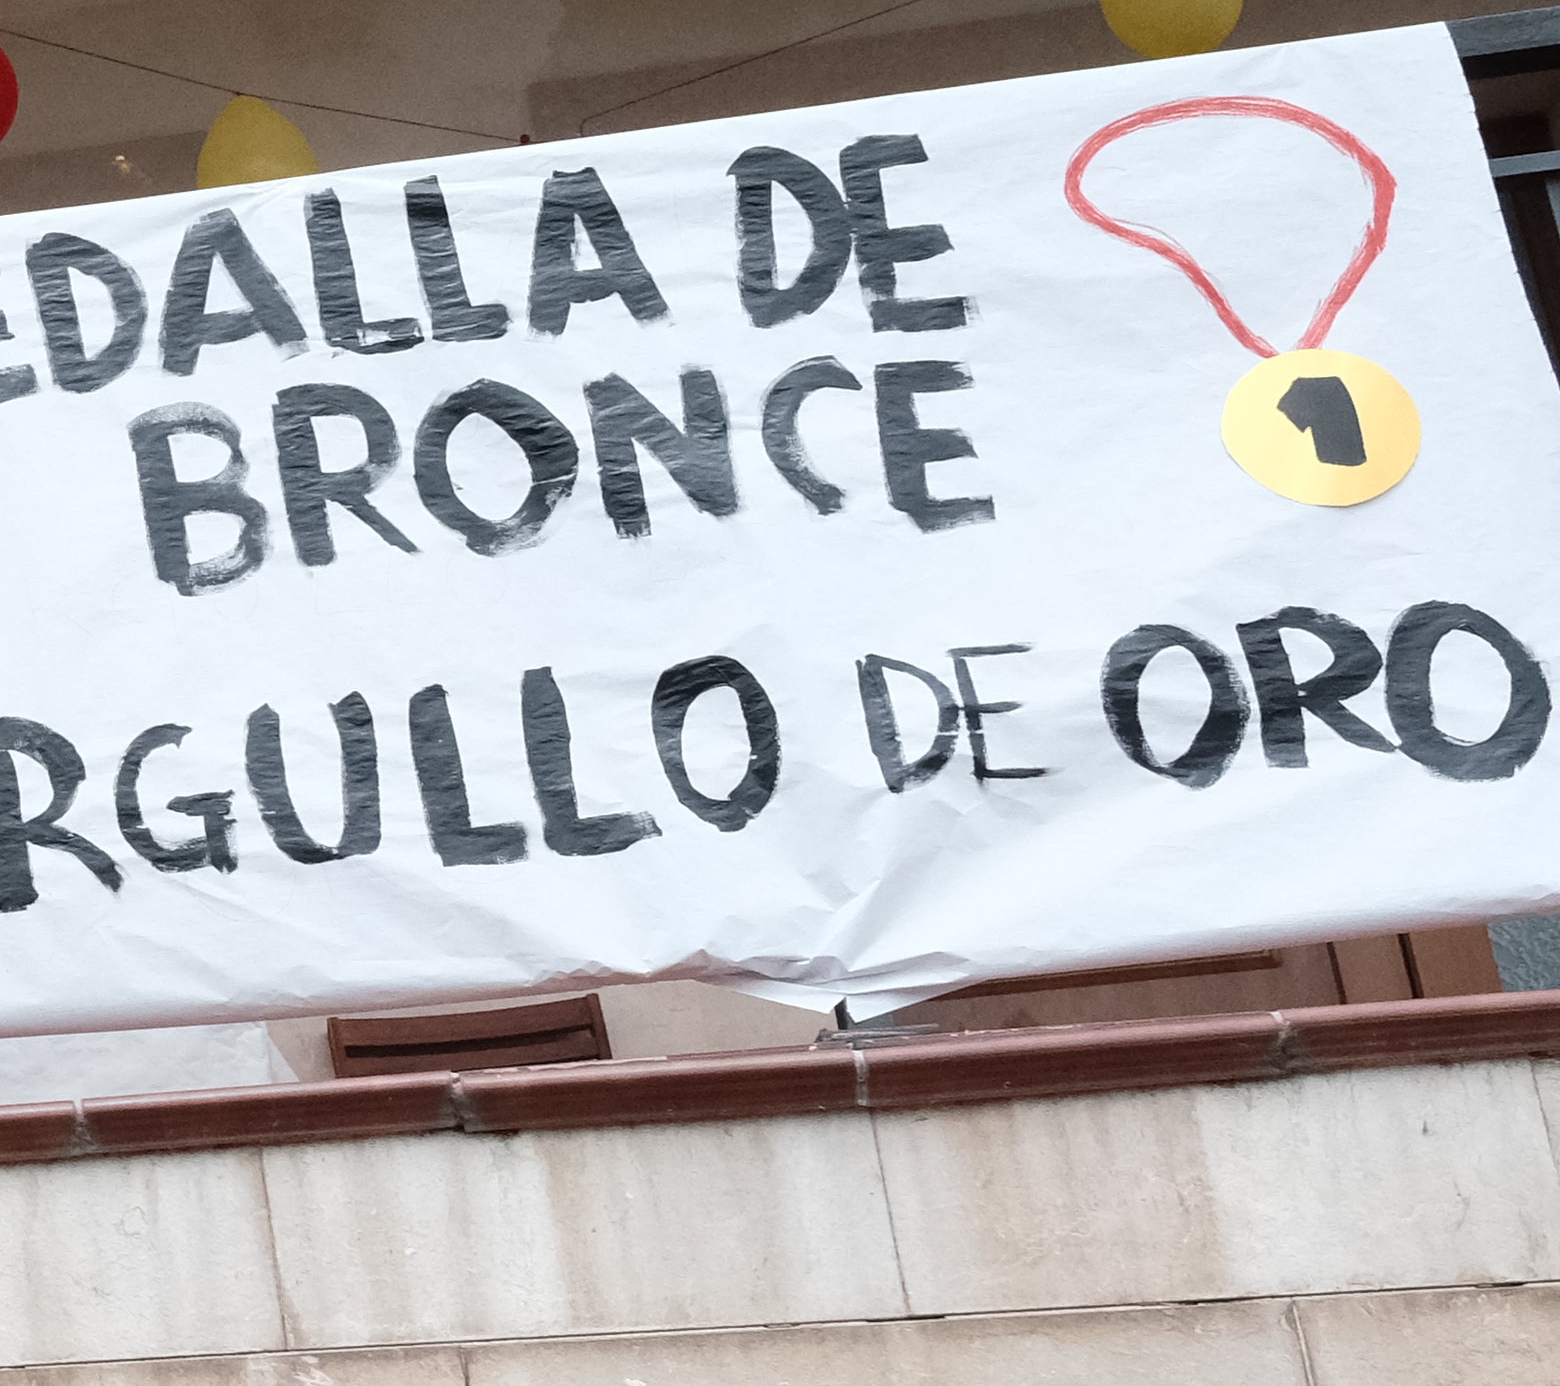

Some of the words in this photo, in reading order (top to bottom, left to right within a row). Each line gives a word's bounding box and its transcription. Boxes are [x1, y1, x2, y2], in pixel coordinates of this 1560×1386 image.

[726, 133, 980, 334] DE
[127, 355, 997, 594] BRONCE
[1276, 375, 1367, 467] 1
[854, 642, 1055, 794] DE
[1098, 599, 1553, 791] ORO
